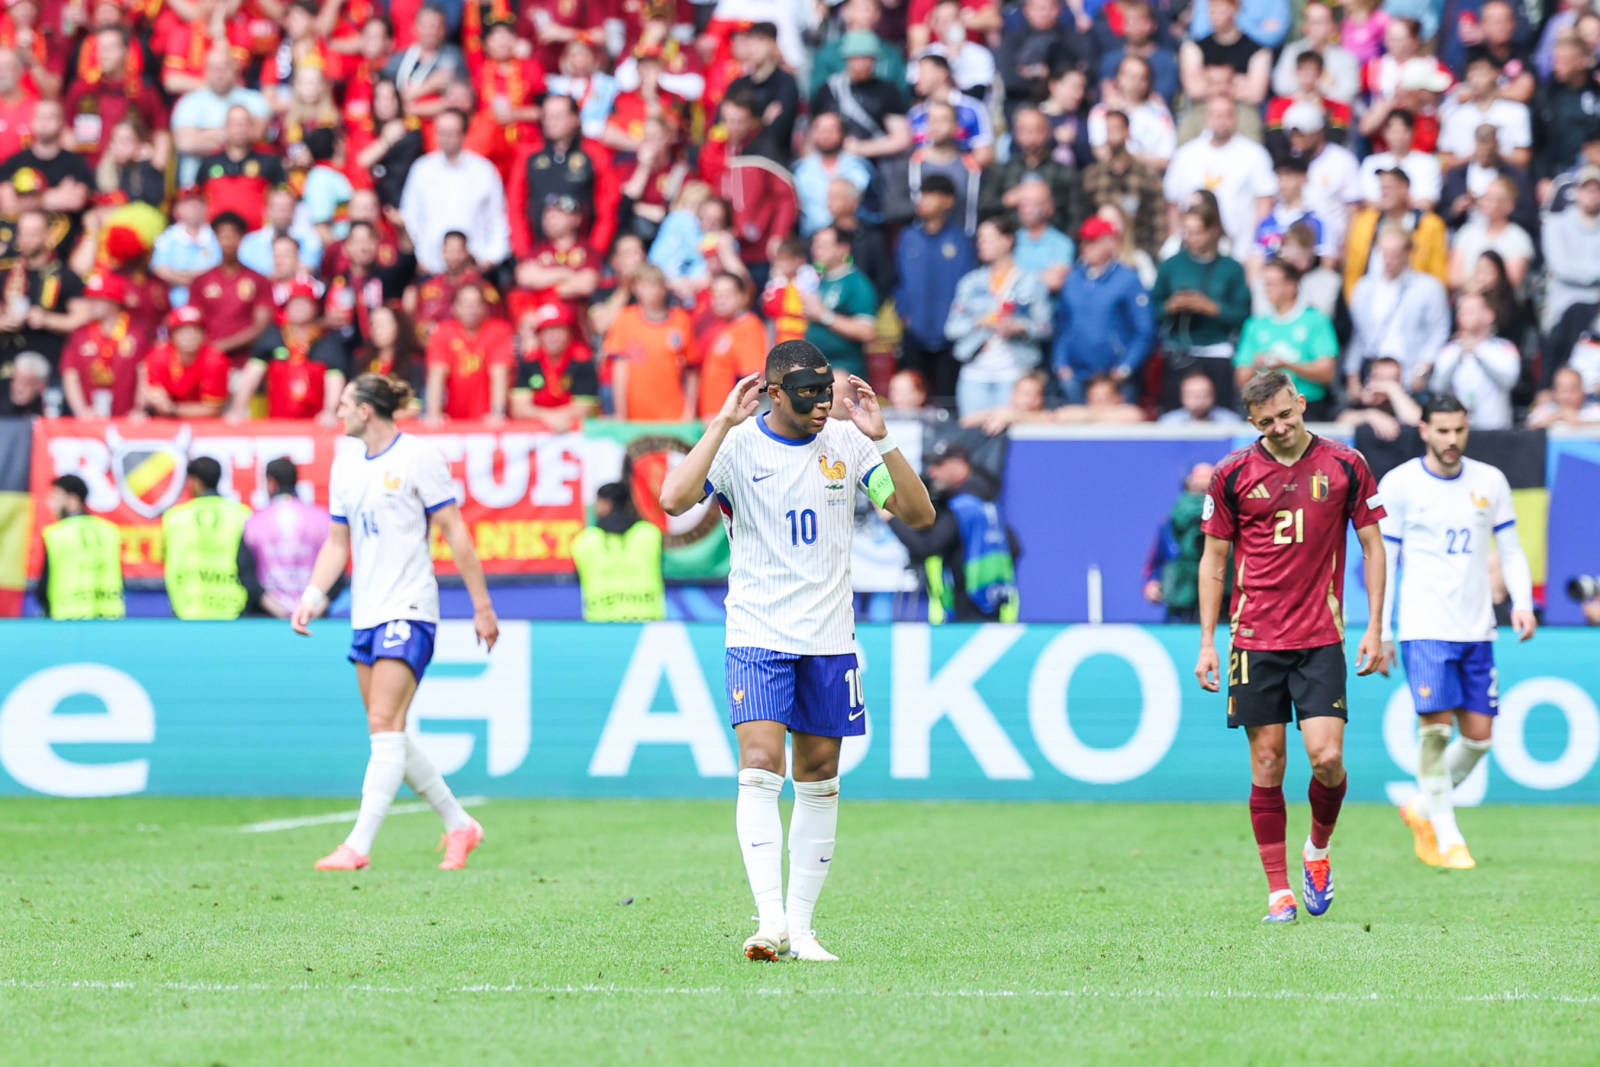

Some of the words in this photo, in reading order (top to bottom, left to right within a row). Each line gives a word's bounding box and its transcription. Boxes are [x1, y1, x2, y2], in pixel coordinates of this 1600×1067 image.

[360, 508, 380, 537] 14
[785, 508, 818, 546] 10
[1273, 508, 1304, 544] 21
[1445, 528, 1473, 555] 22
[1228, 650, 1249, 687] 21
[589, 624, 1182, 784] AKO
